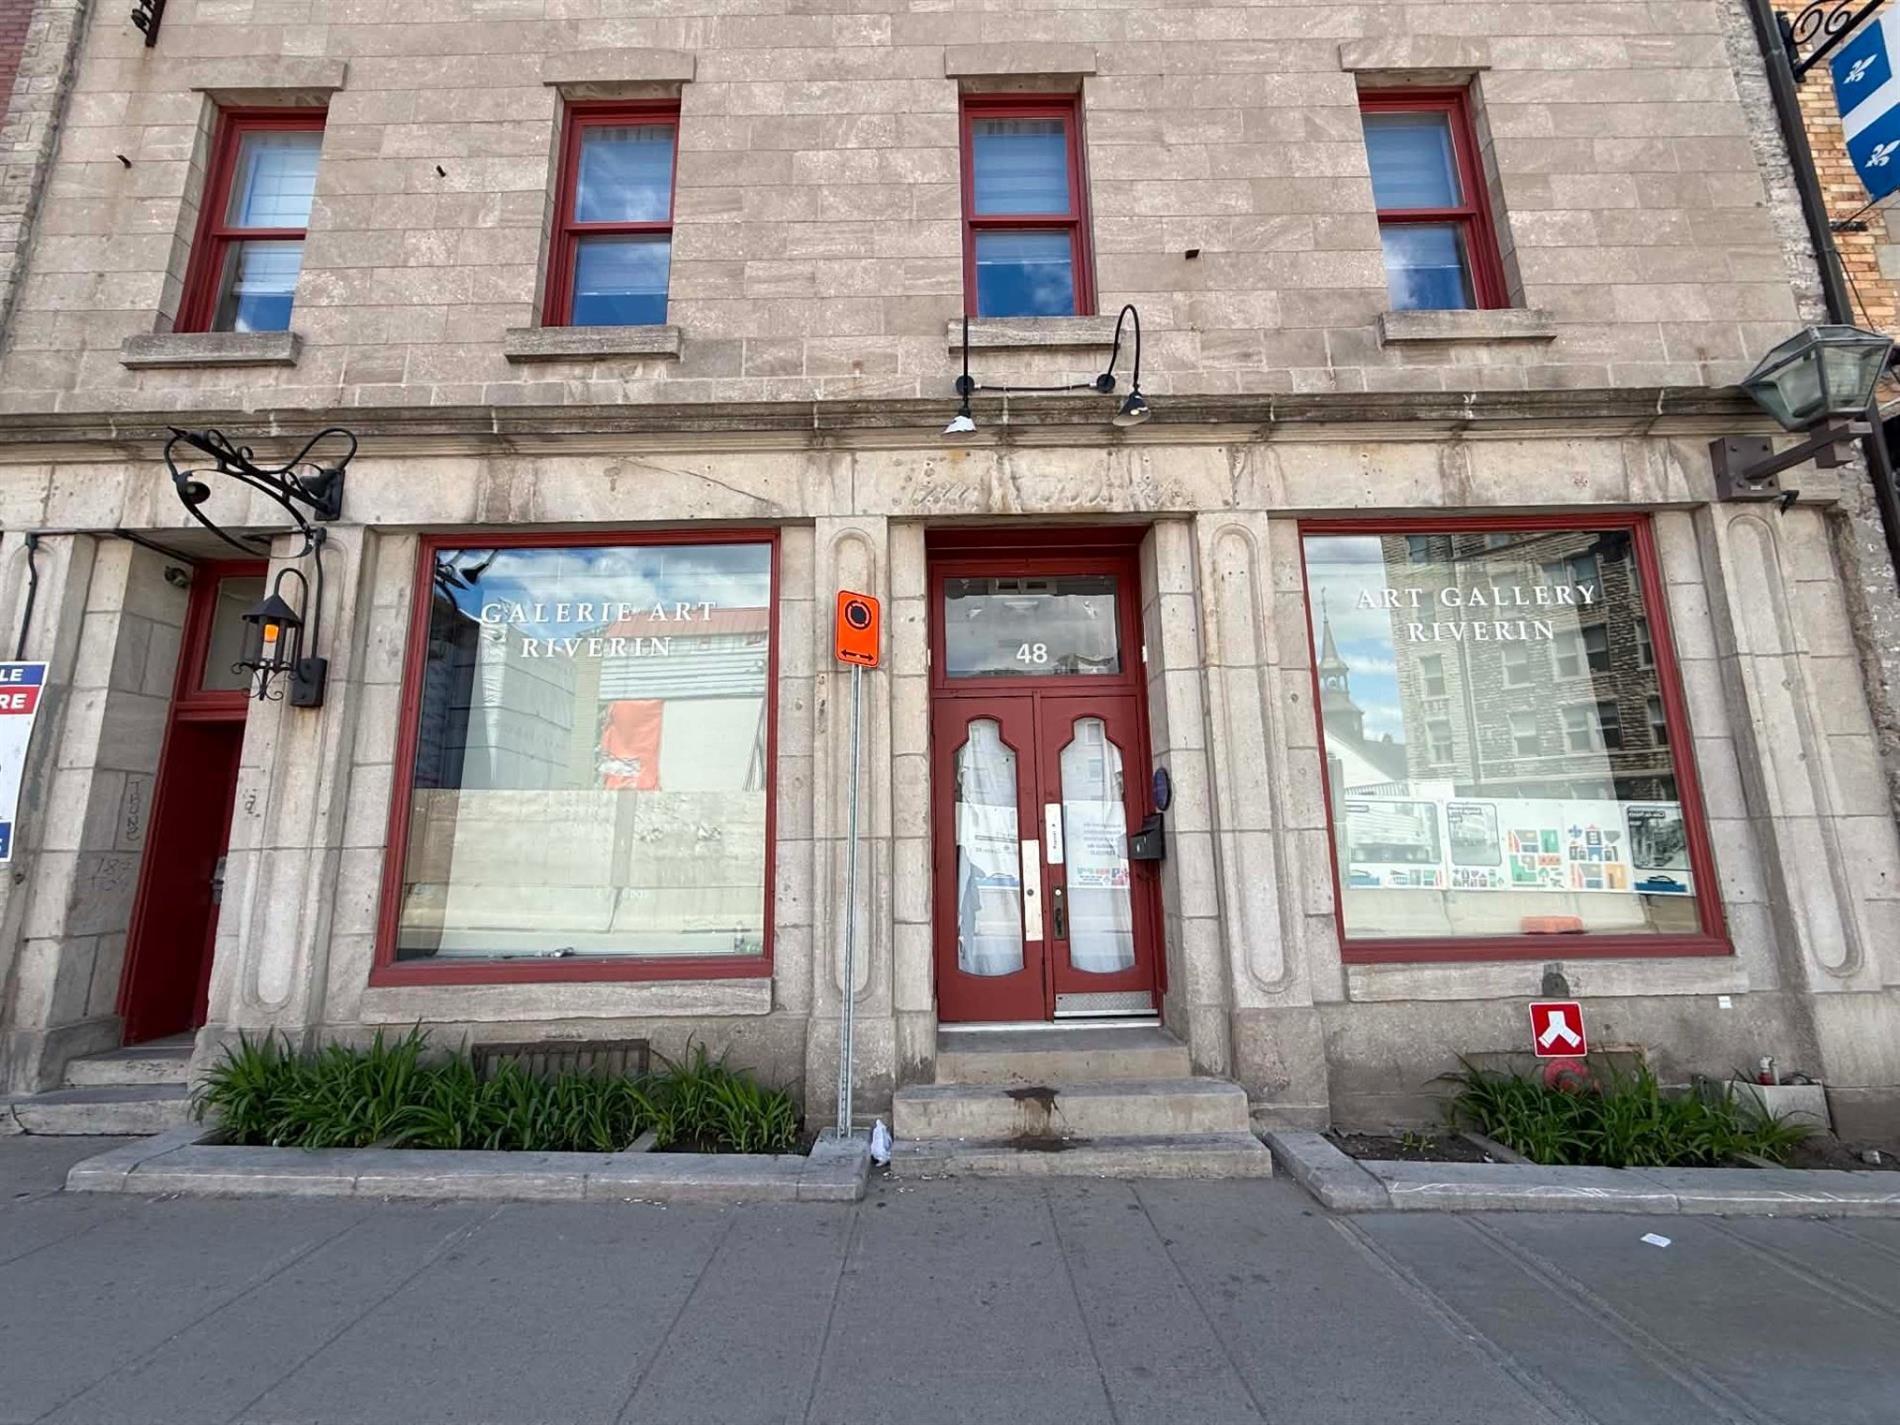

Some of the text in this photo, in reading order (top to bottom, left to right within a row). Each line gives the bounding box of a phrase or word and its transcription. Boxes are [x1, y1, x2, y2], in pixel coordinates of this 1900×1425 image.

[1357, 584, 1595, 609] ART GALLERY
[481, 601, 717, 624] GALERIE ART
[1408, 620, 1555, 642] RIVERIN
[521, 636, 673, 658] RIVERIN
[1016, 643, 1048, 664] 48
